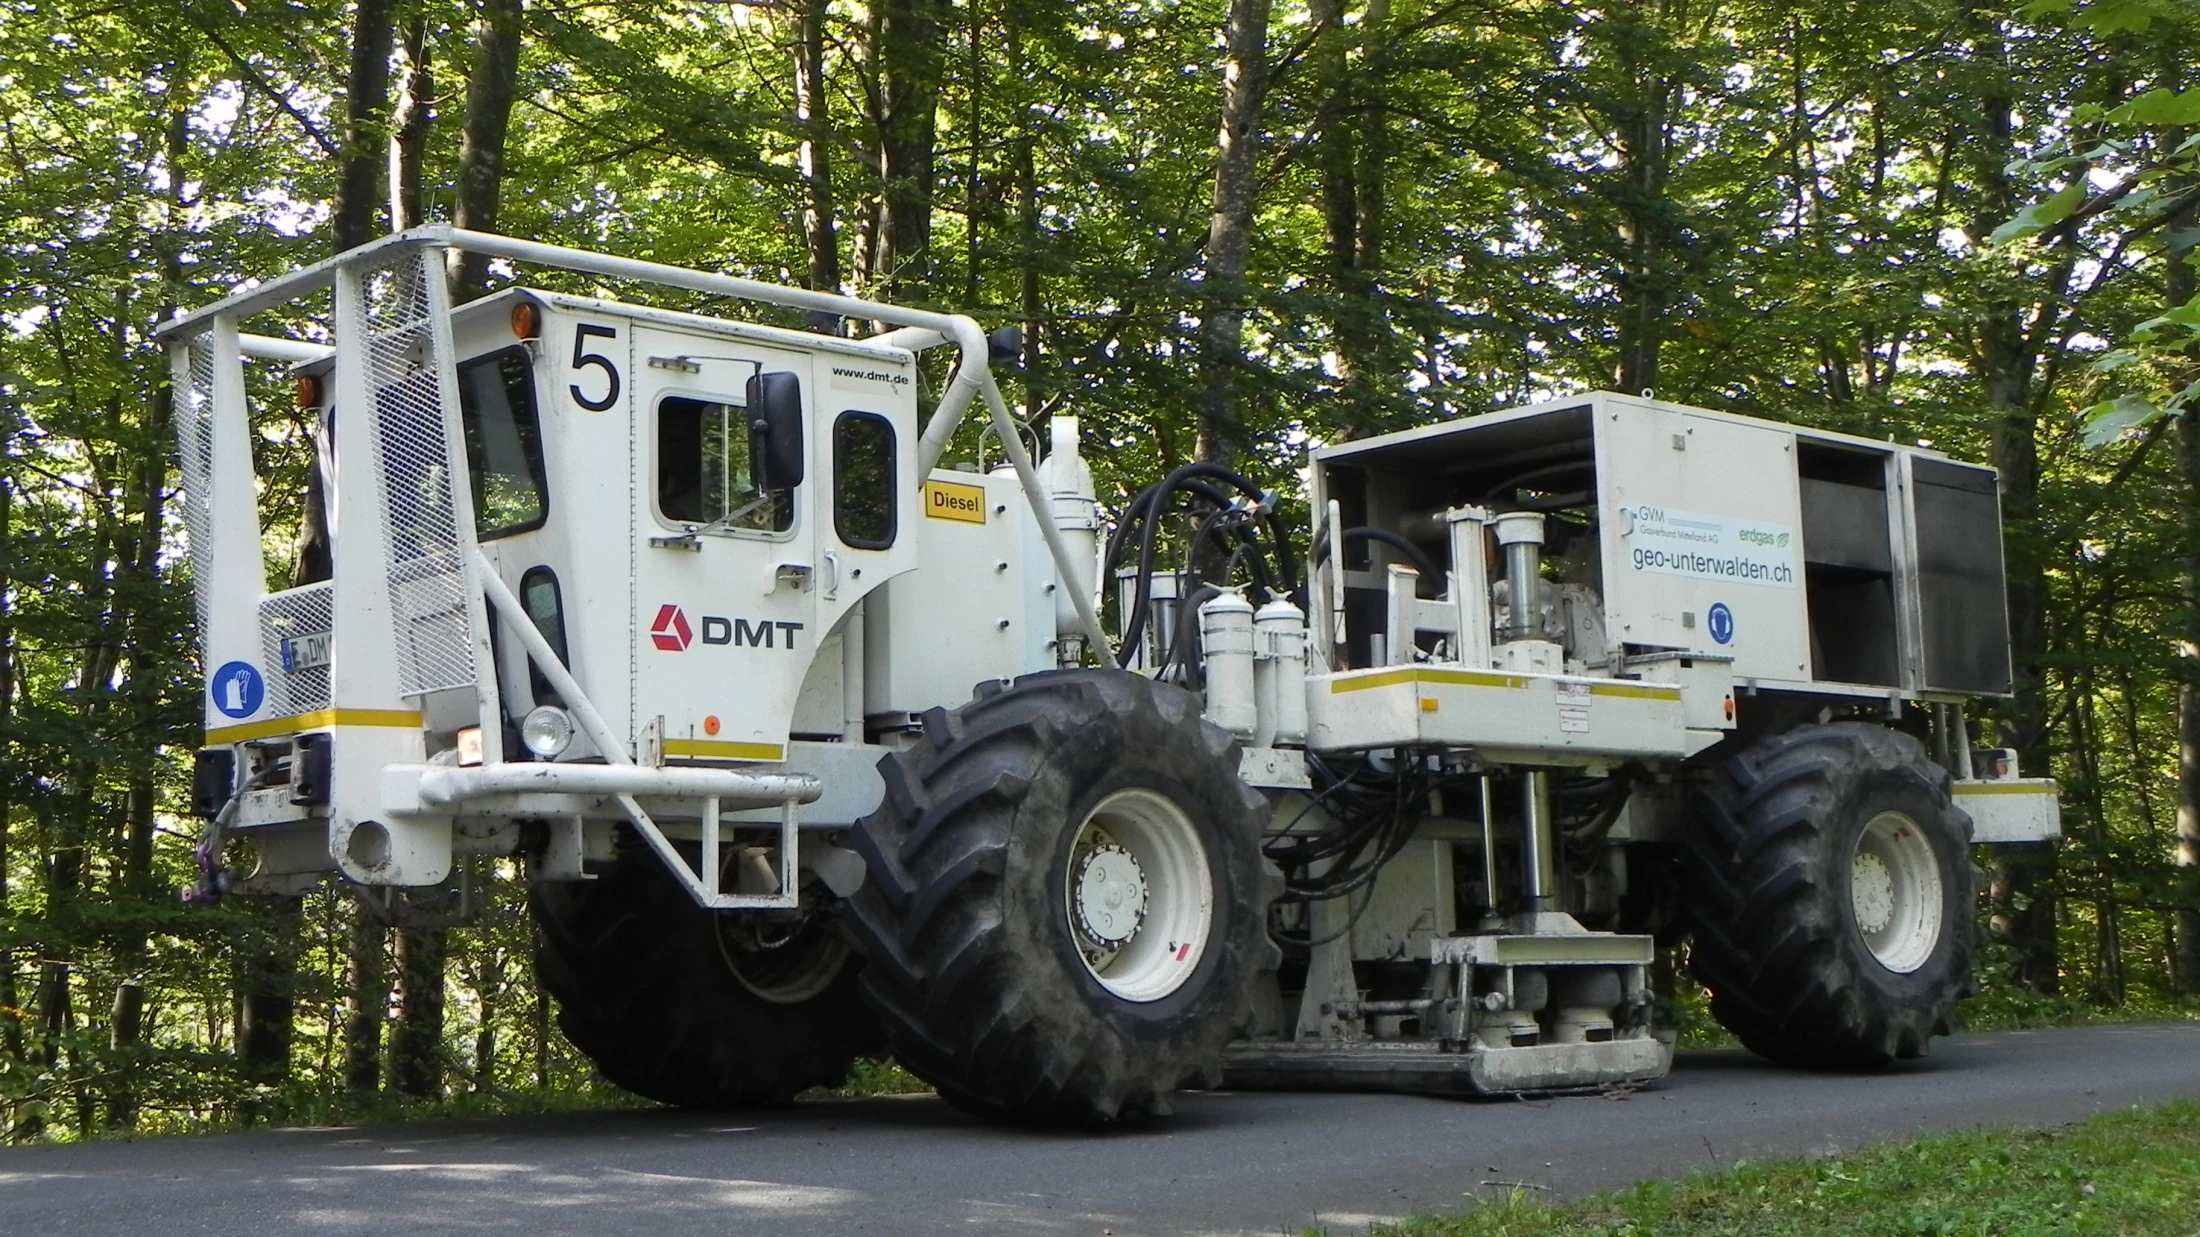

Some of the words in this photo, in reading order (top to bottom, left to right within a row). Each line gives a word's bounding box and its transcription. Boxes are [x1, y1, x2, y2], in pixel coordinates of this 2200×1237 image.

[570, 323, 620, 412] 5
[832, 367, 909, 385] www.dmt.de
[934, 491, 979, 512] Diesel
[1639, 506, 1666, 523] GVM
[1640, 525, 1677, 539] Gasverbund
[1678, 530, 1707, 543] Mittelland
[1708, 534, 1719, 544] AG
[1739, 528, 1775, 546] erdgas
[1633, 548, 1792, 583] geo-unterwalden.ch
[702, 616, 804, 649] DMT
